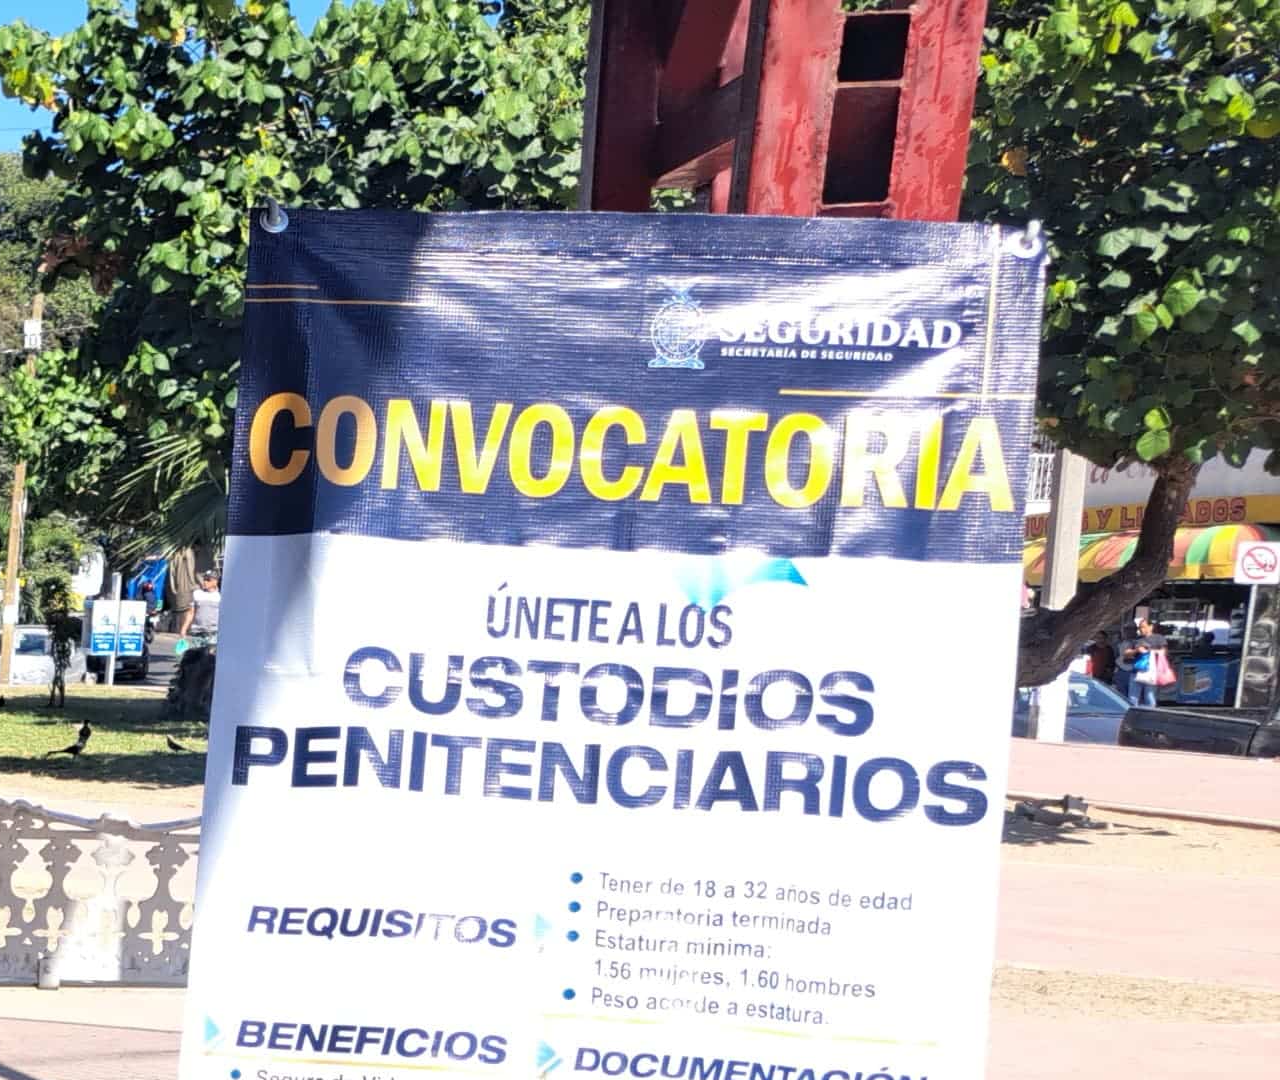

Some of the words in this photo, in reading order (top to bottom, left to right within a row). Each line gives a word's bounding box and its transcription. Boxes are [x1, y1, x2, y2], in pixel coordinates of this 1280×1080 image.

[718, 317, 962, 349] SEGURIDAD
[720, 345, 797, 358] SECRETARÍA
[821, 349, 894, 362] SEGURIDAD
[248, 390, 1016, 512] CONVOCATORIA
[1096, 508, 1113, 529] Y
[1120, 497, 1248, 531] LIADOS
[485, 583, 612, 644] ÚNETE
[615, 601, 644, 645] A
[656, 602, 734, 650] LOS
[342, 644, 876, 737] CUSTODIOS
[232, 724, 990, 827] PENITENCIARIOS
[599, 871, 653, 895] Tener
[660, 877, 684, 897] de
[693, 879, 716, 898] 18
[744, 881, 768, 899] 32
[828, 888, 852, 907] de
[858, 890, 913, 911] edad
[246, 904, 517, 948] REQUISITOS
[595, 929, 678, 953] Estatura
[731, 911, 832, 936] terminada
[591, 986, 639, 1010] Peso
[594, 958, 632, 979] 1.56
[740, 968, 780, 990] 1.60
[784, 974, 876, 999] hombres
[235, 1019, 508, 1065] BENEFICIOS
